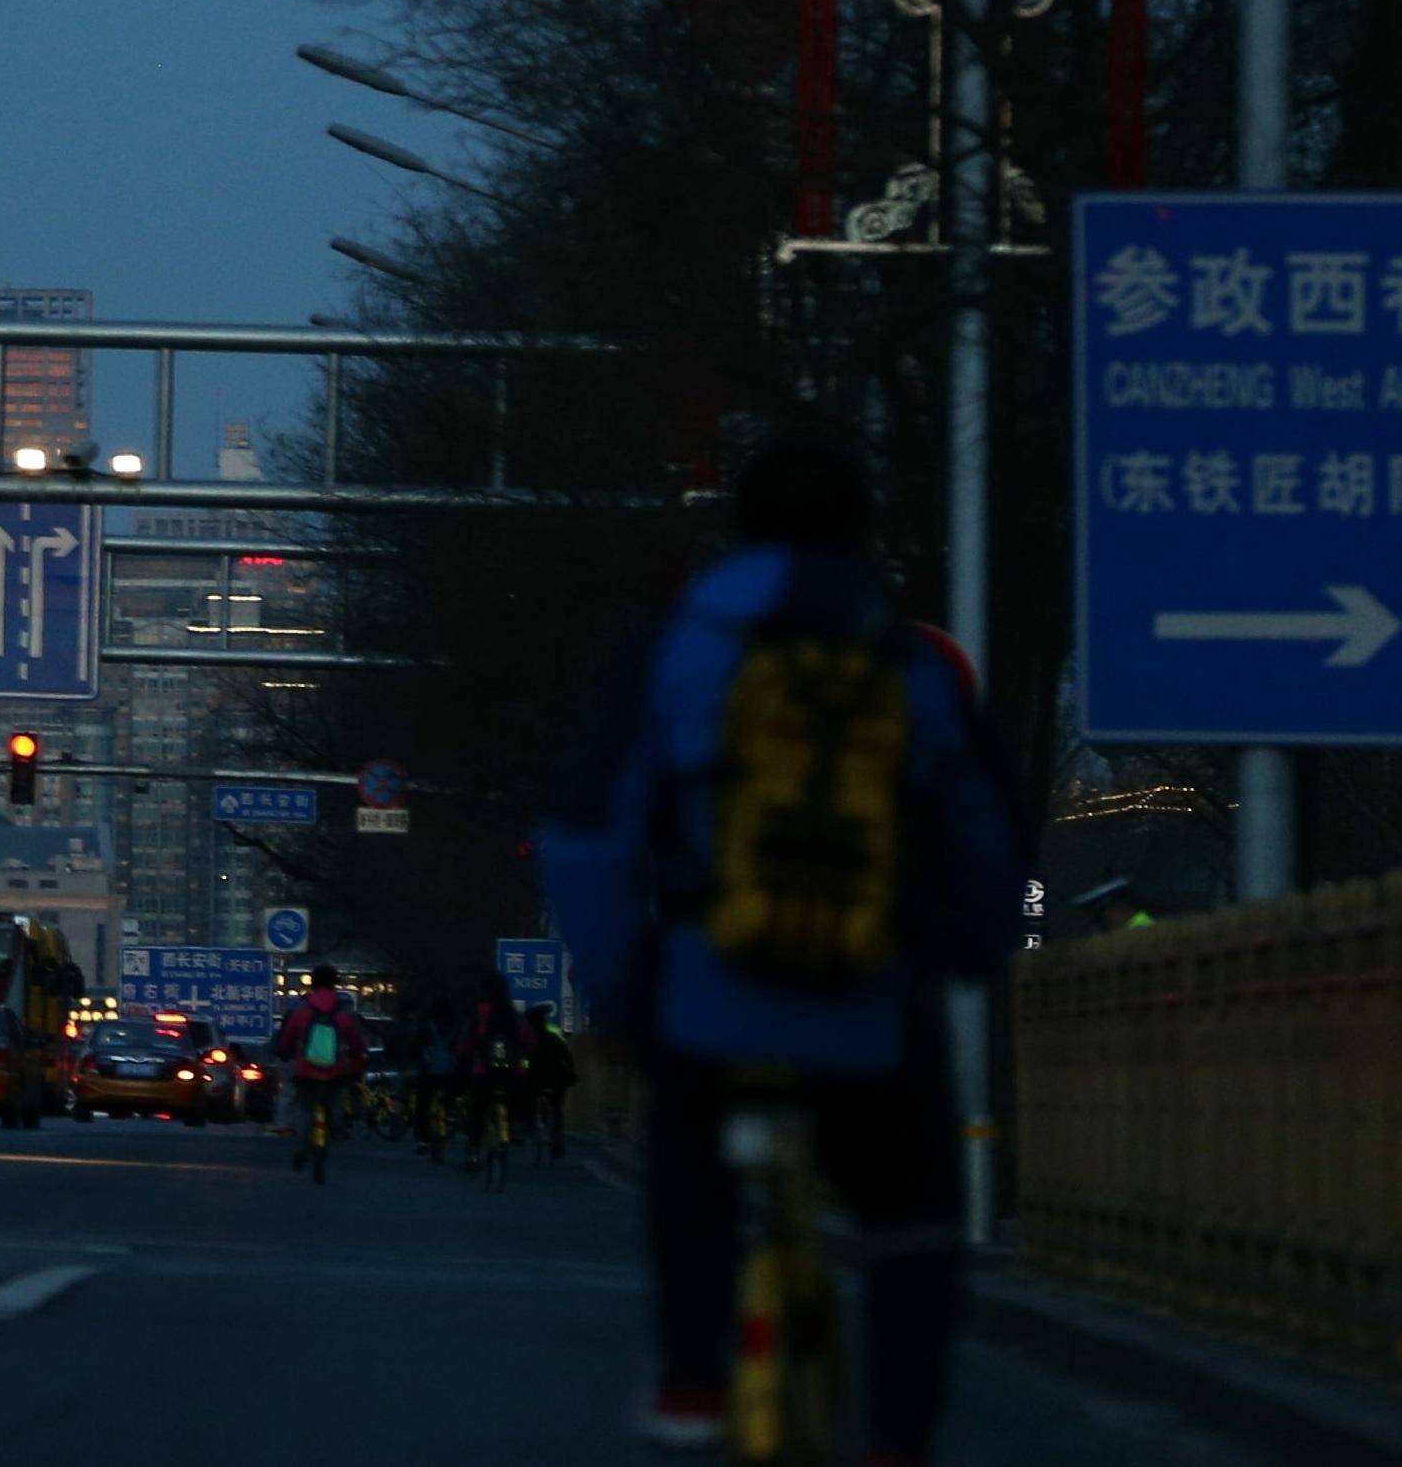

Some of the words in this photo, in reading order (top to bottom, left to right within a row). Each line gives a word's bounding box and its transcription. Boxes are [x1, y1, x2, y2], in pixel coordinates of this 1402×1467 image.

[1102, 360, 1275, 409] CANZHENG
[1289, 363, 1366, 410] West
[1098, 447, 1402, 517] (东铁匠胡
